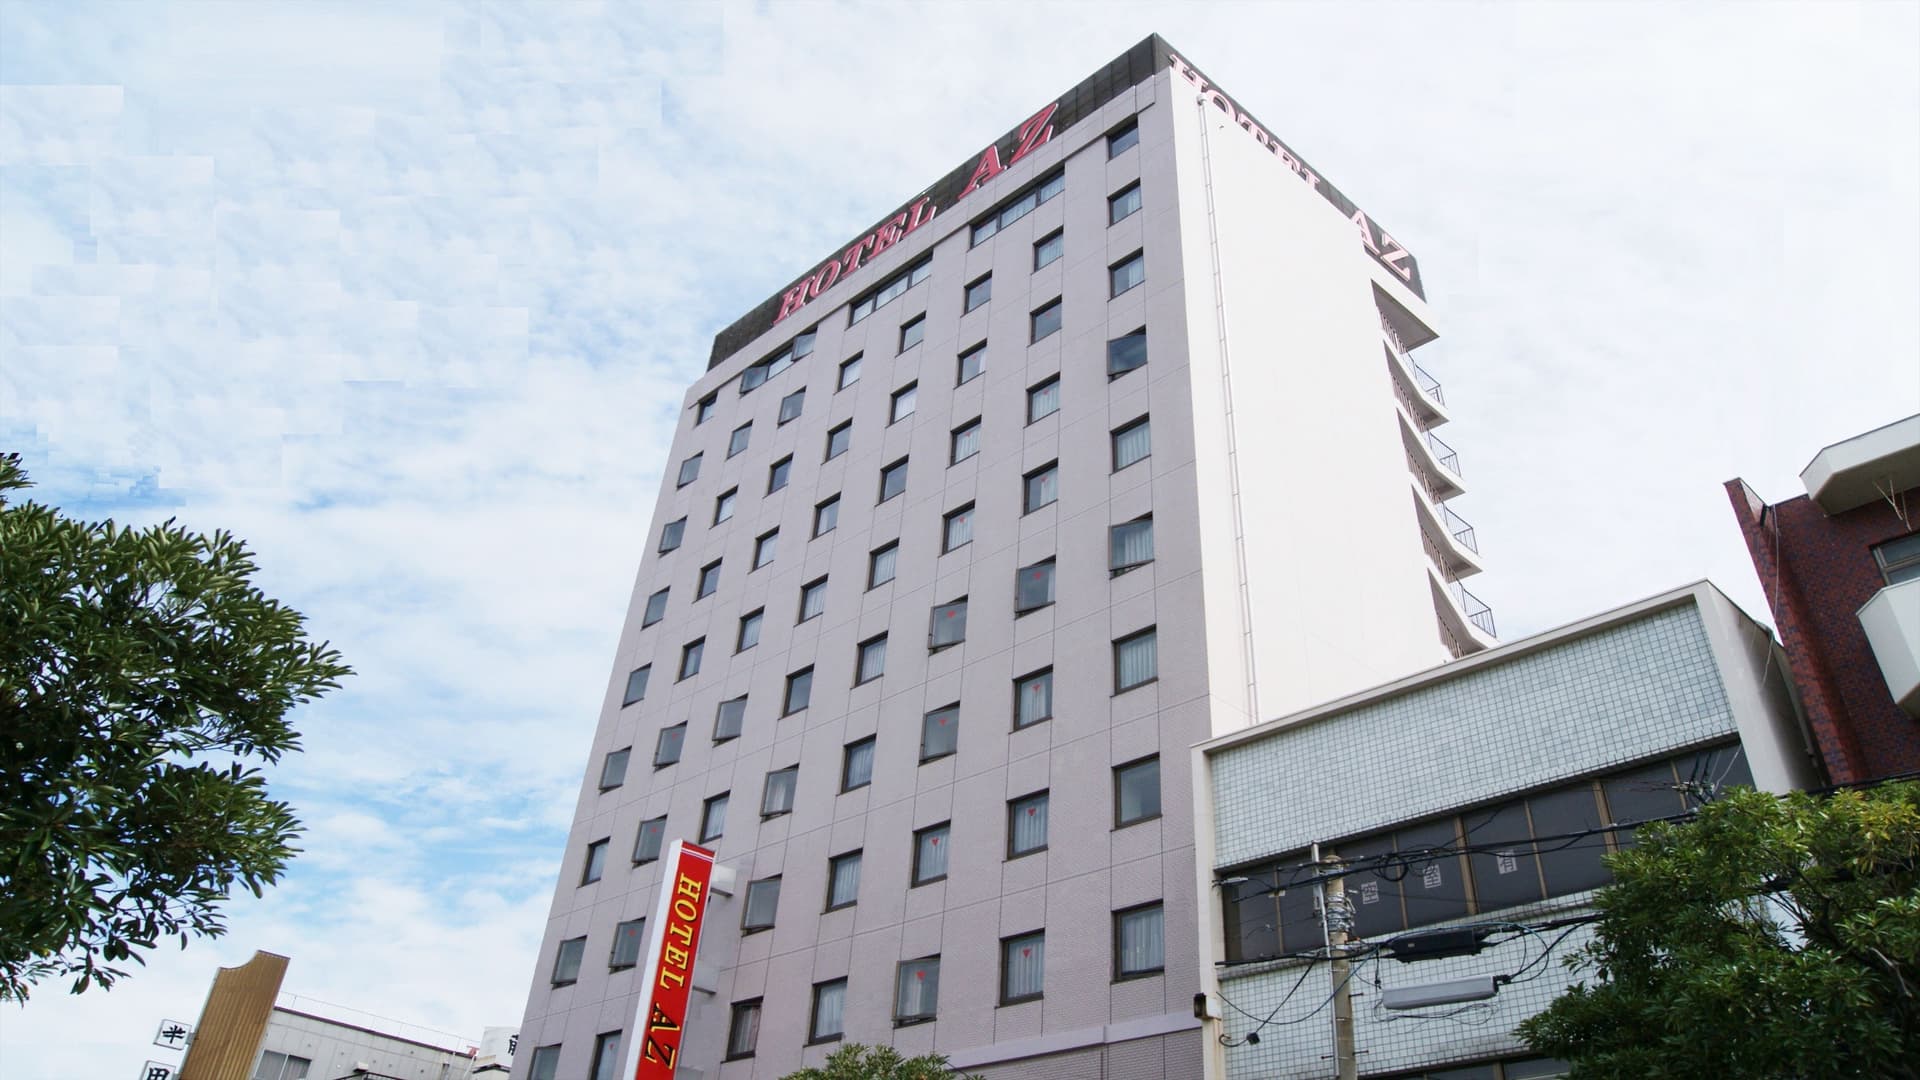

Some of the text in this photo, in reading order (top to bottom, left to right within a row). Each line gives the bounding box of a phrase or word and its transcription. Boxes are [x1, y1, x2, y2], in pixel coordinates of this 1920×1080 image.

[773, 103, 1059, 326] HOTEL AZ
[1351, 209, 1411, 281] AZ
[645, 873, 702, 1070] HOTEL AZ
